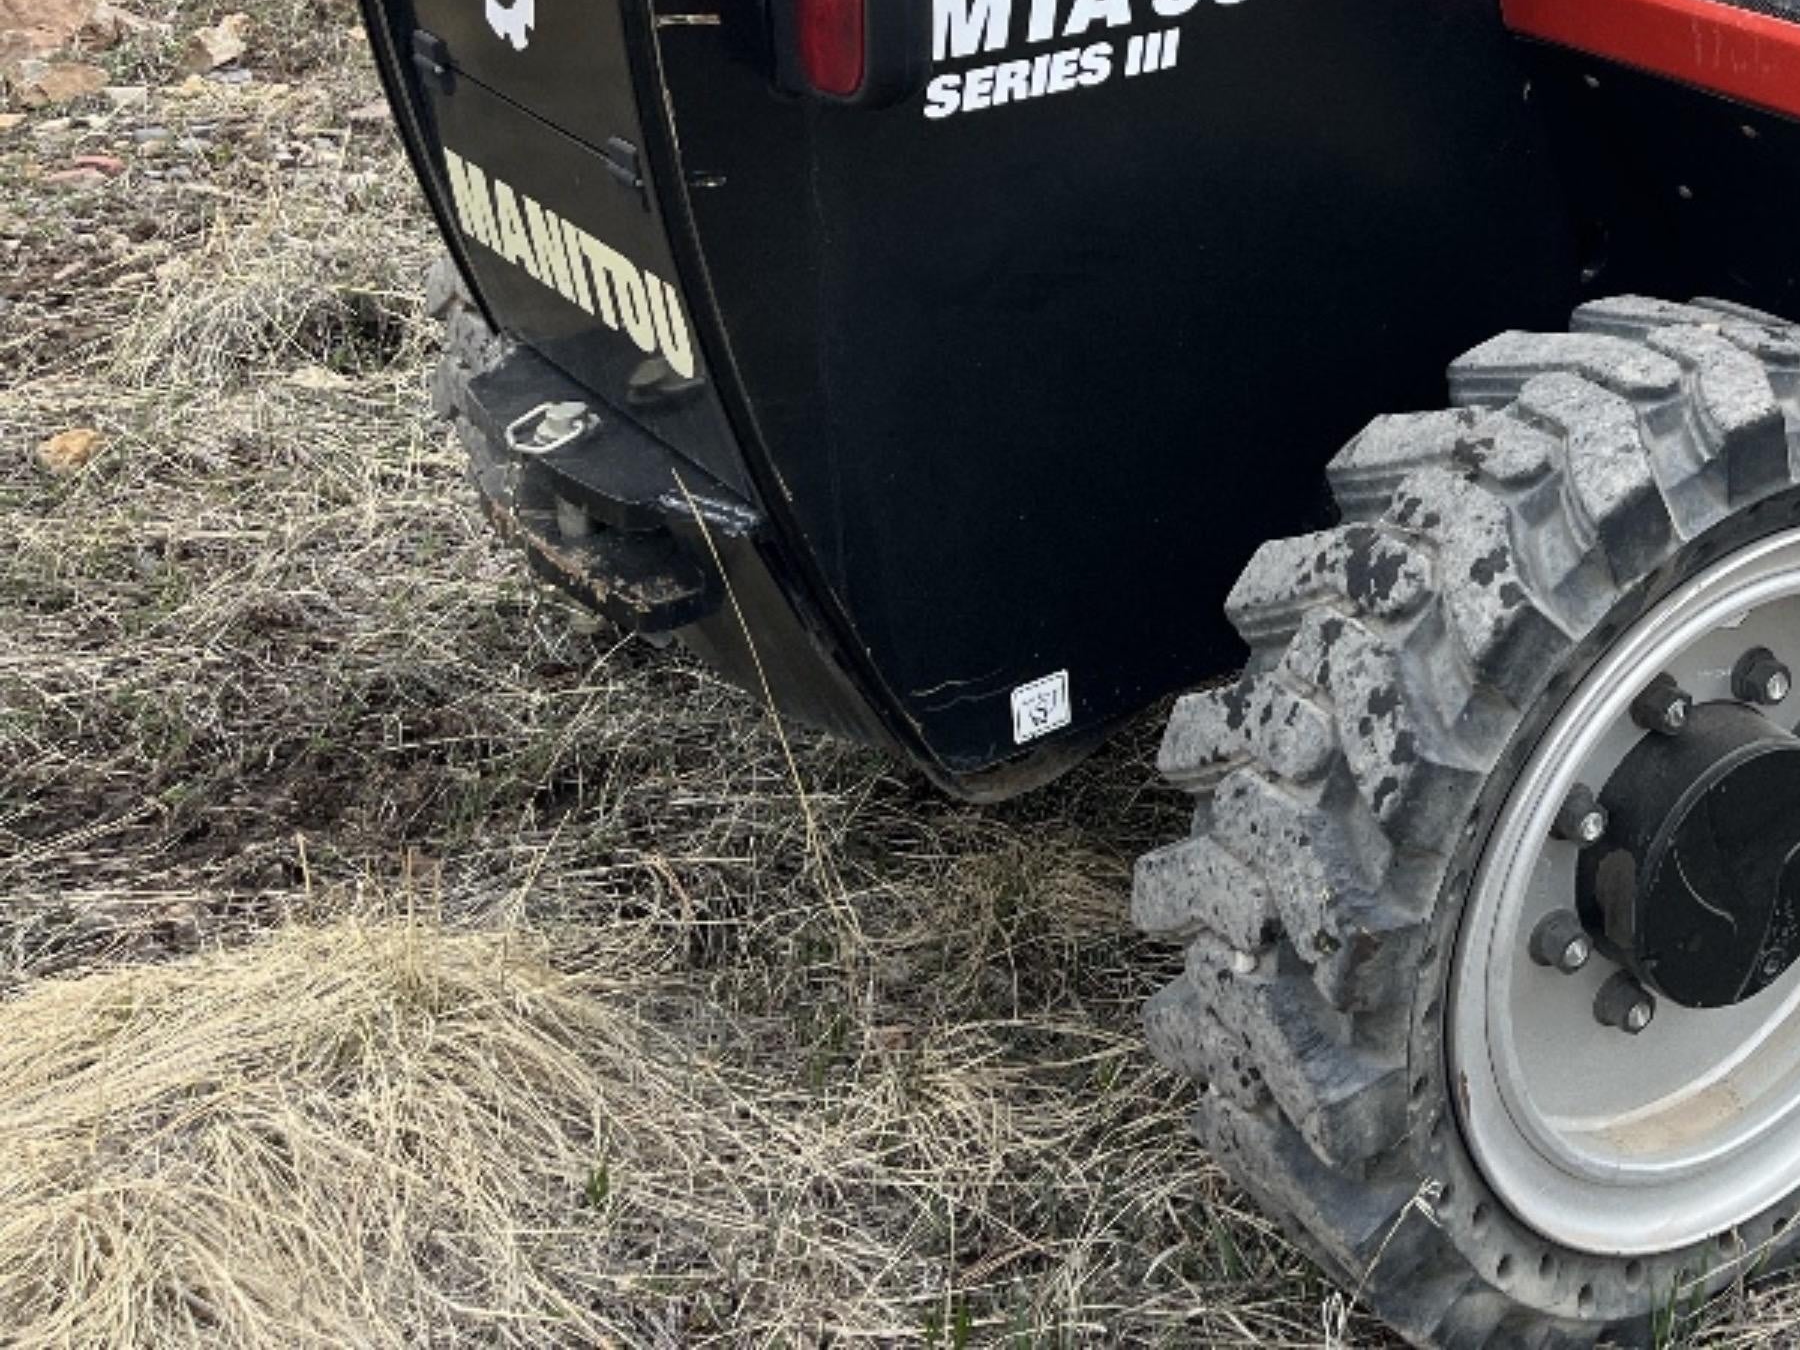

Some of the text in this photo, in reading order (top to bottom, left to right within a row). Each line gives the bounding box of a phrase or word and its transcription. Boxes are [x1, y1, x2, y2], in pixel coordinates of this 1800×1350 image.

[923, 27, 1181, 120] SERIES III
[444, 146, 694, 379] MANITOU
